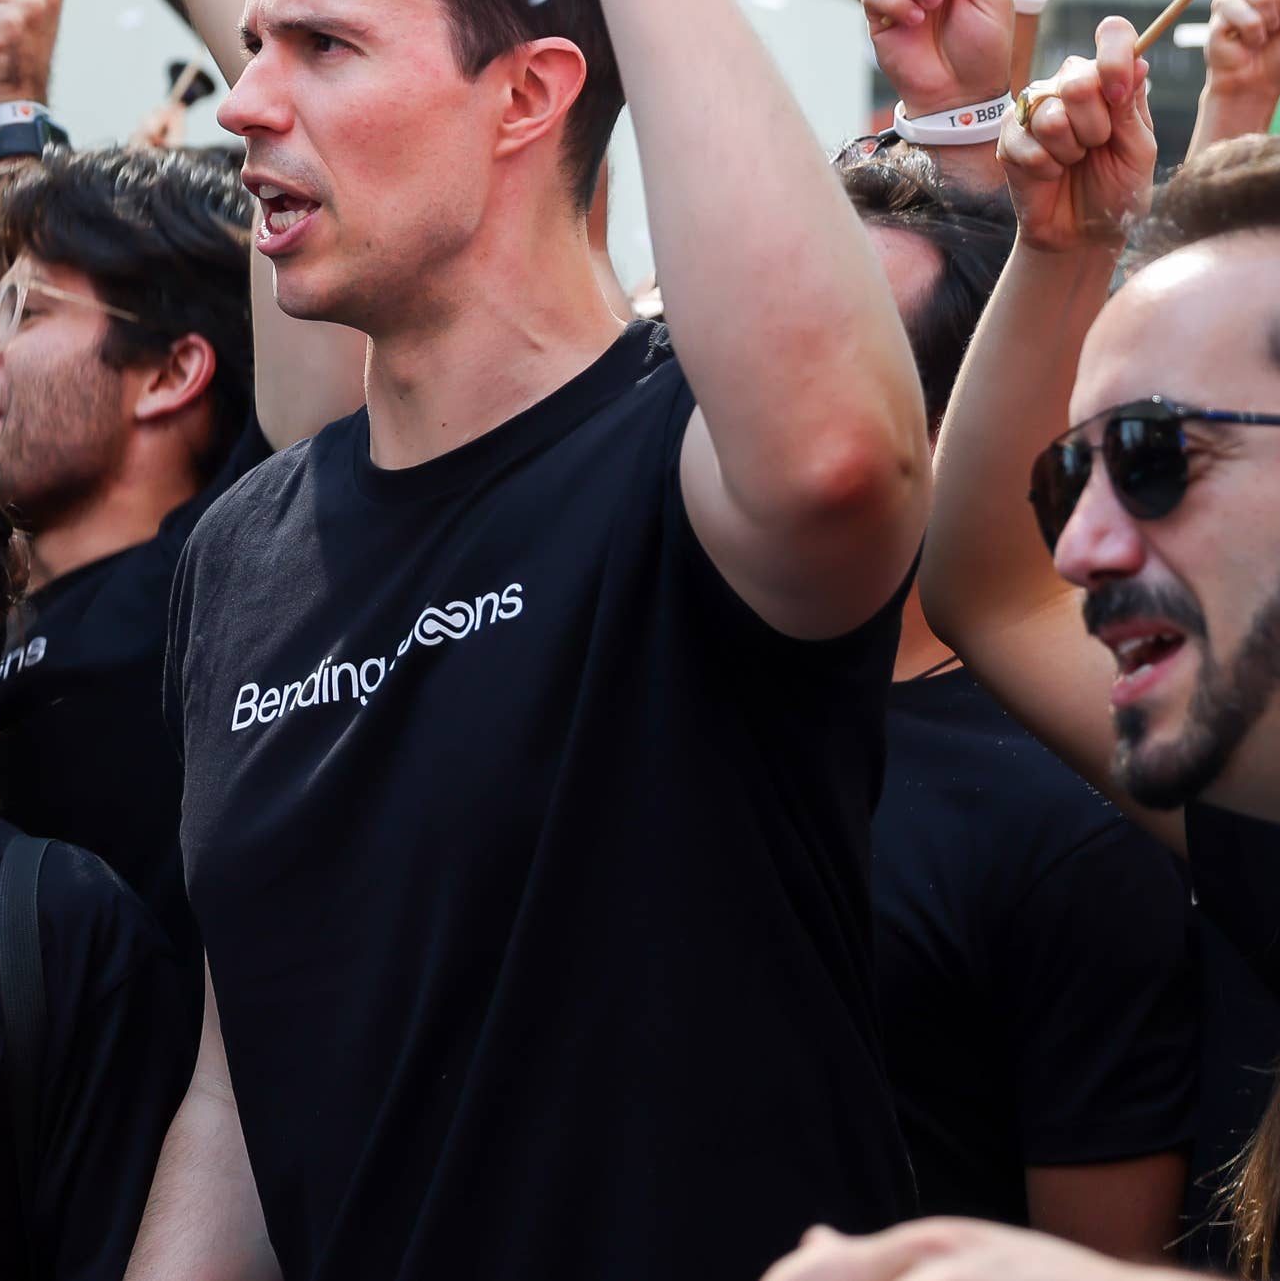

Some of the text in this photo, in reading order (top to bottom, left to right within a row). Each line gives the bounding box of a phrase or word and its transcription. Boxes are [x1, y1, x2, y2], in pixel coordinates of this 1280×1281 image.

[948, 103, 1005, 128] I BSP
[231, 583, 523, 732] Bending oons
